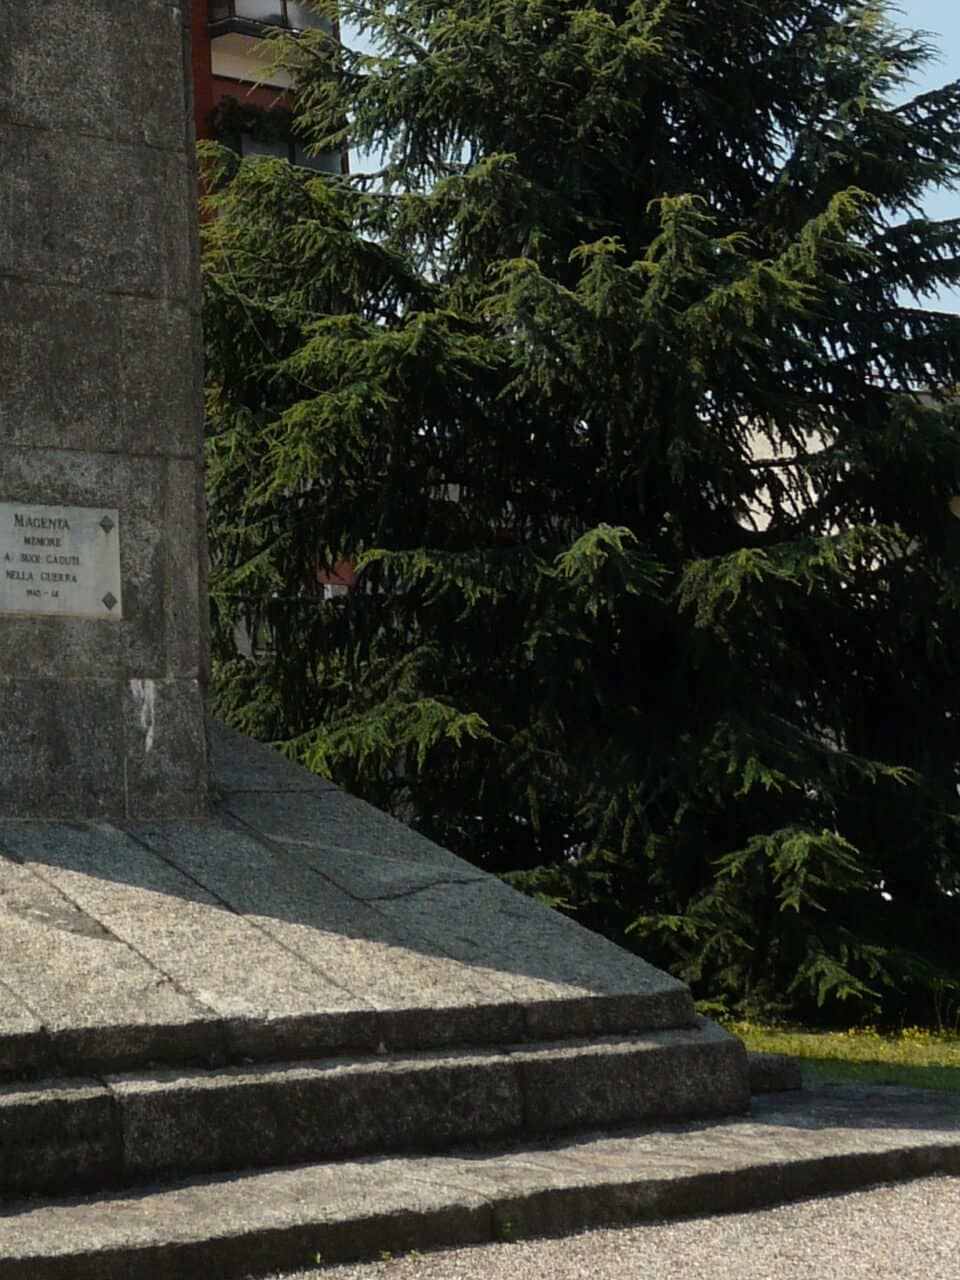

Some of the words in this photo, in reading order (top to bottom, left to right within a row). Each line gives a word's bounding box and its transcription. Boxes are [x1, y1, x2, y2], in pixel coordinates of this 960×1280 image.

[14, 513, 70, 530] MAGENTA
[46, 555, 79, 566] CADUTI
[6, 570, 33, 581] NELLA
[41, 572, 77, 583] GUERRA
